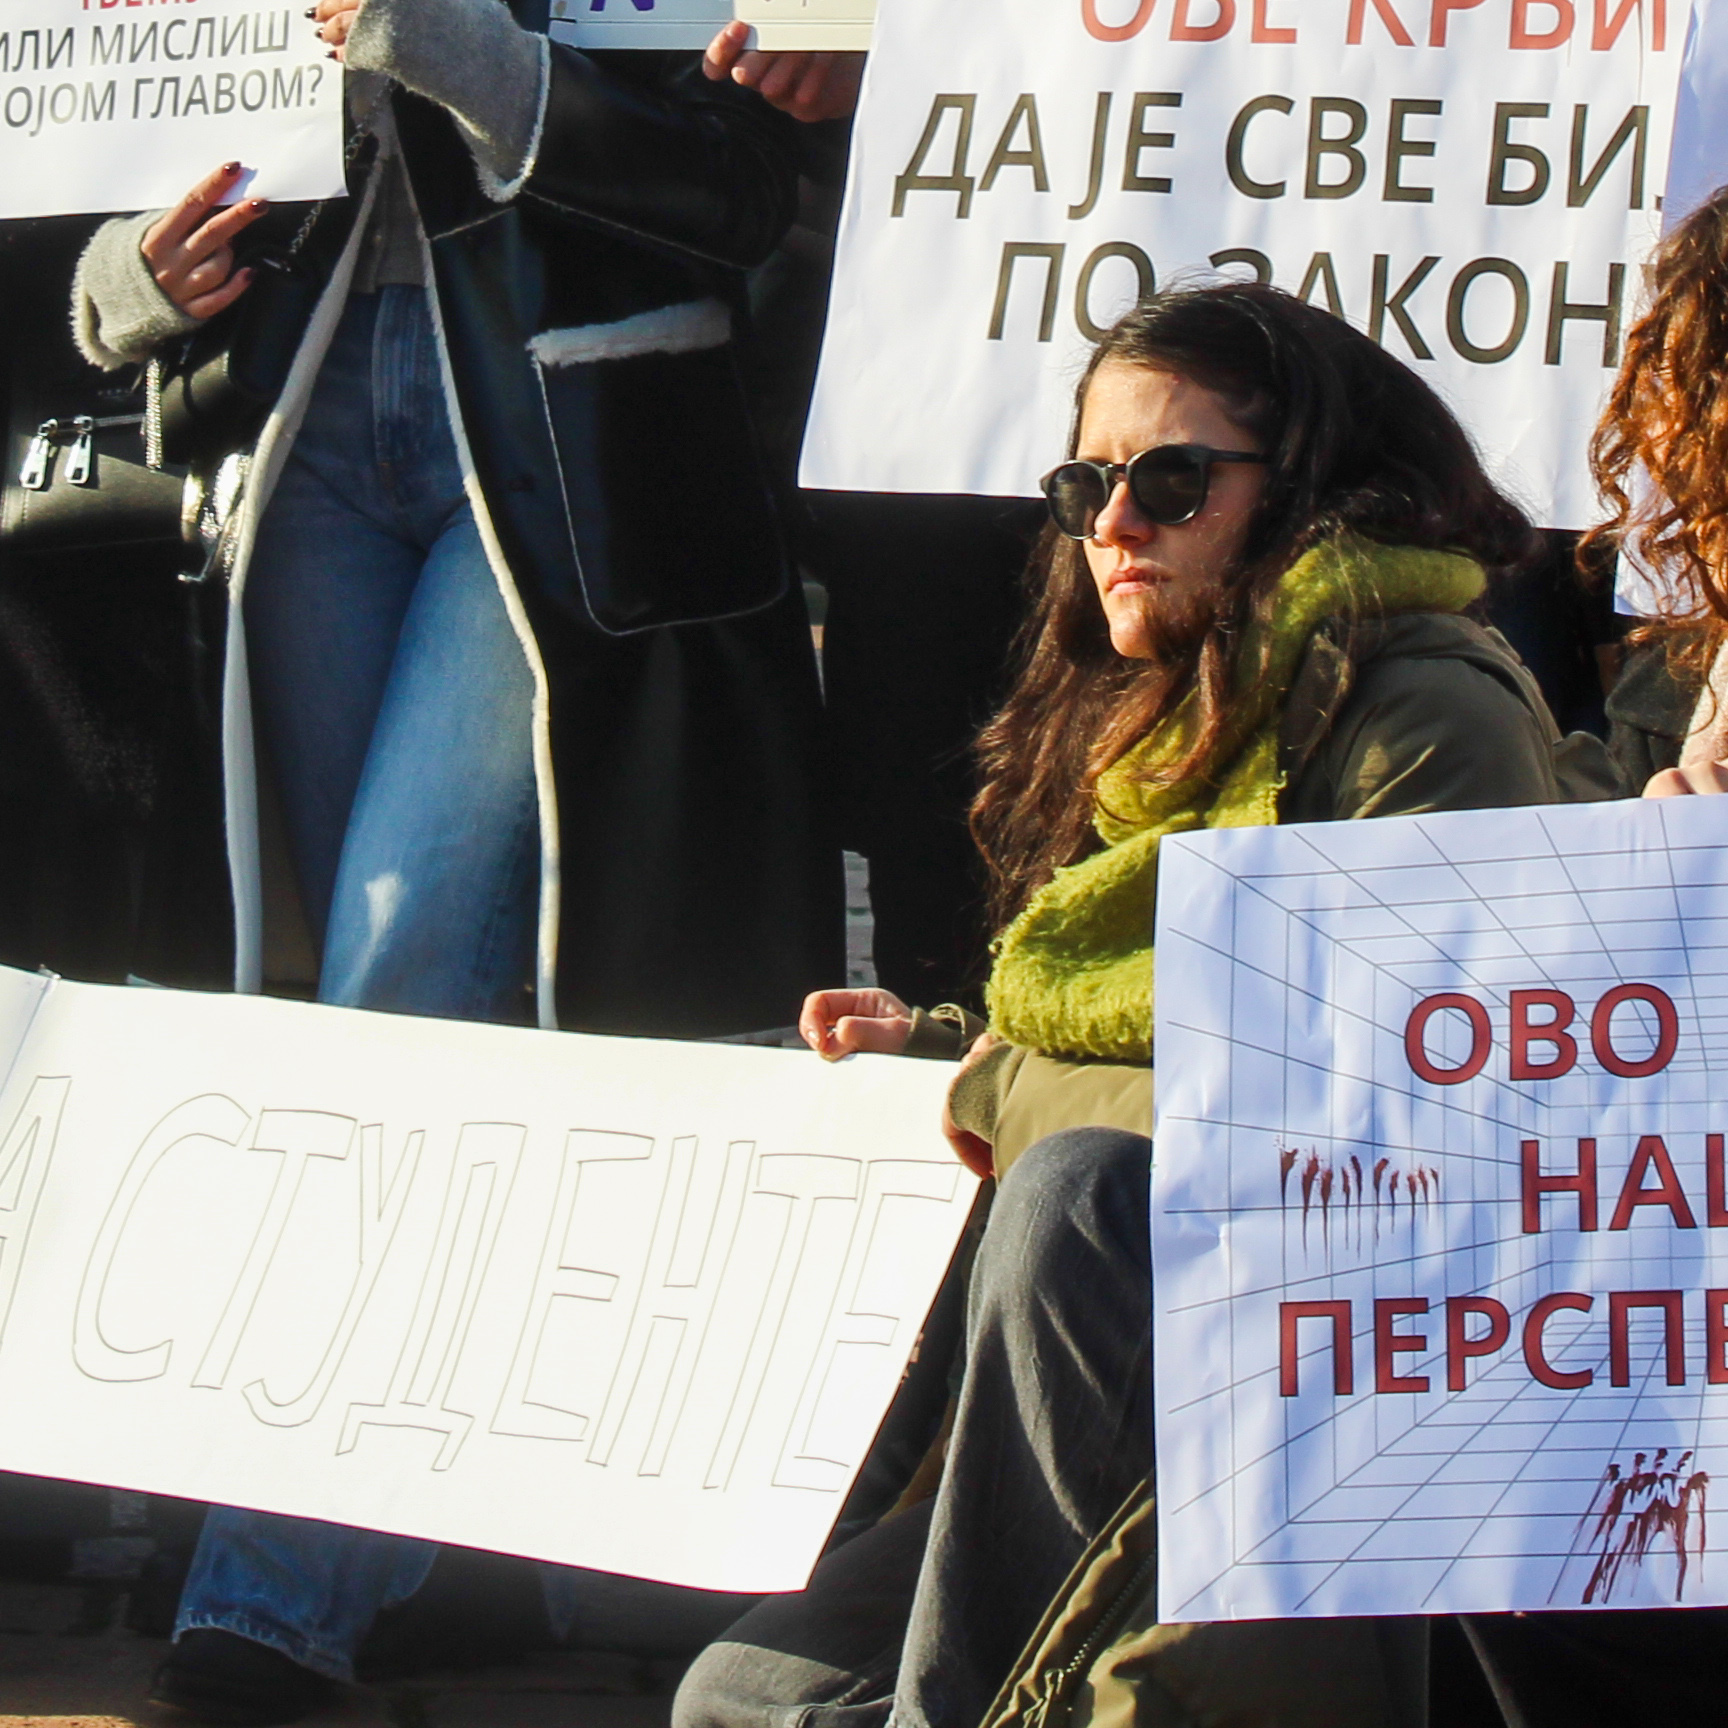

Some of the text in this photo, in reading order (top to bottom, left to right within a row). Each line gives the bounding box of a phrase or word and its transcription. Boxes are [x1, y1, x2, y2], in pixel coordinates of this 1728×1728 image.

[89, 8, 291, 67] МИСЛИШ
[130, 64, 325, 124] ГЛАВОМ?
[1223, 95, 1444, 206] СВЕ
[1485, 101, 1663, 211] БИ
[986, 240, 1158, 344] ПО
[1402, 980, 1681, 1088] ОВО
[71, 1092, 964, 1494] СТУДЕНТЕ
